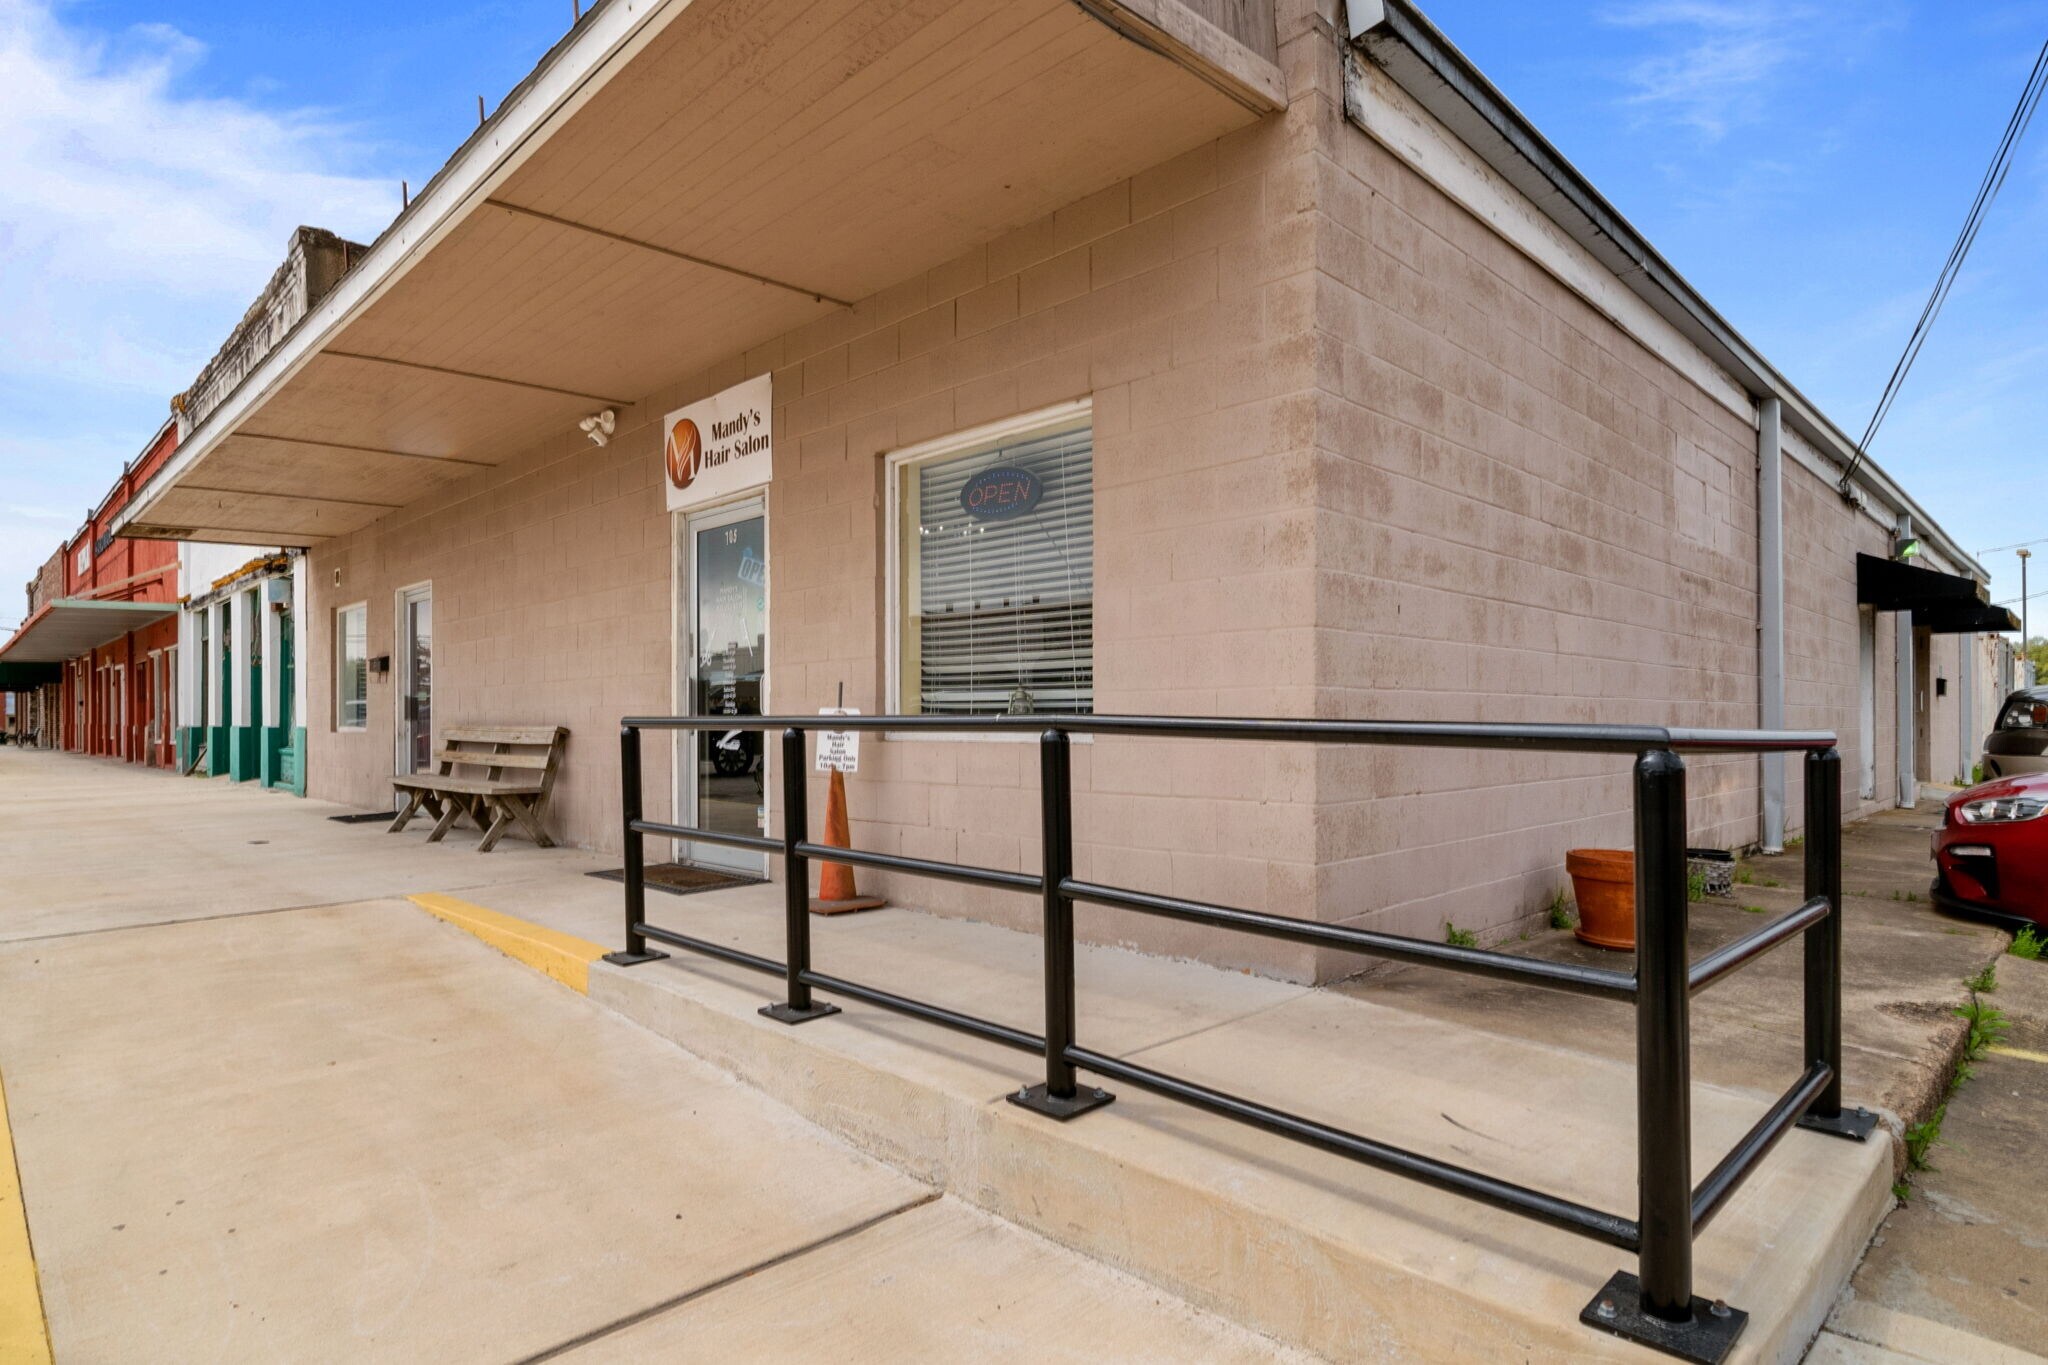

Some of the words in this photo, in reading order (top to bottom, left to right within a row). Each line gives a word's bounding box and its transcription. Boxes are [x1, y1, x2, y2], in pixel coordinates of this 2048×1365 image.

[711, 408, 761, 442] Mandy's
[704, 445, 731, 469] Hair
[734, 433, 769, 459] Salon
[968, 480, 1031, 507] OPEN
[741, 559, 765, 584] OPE
[818, 754, 842, 762] Parking
